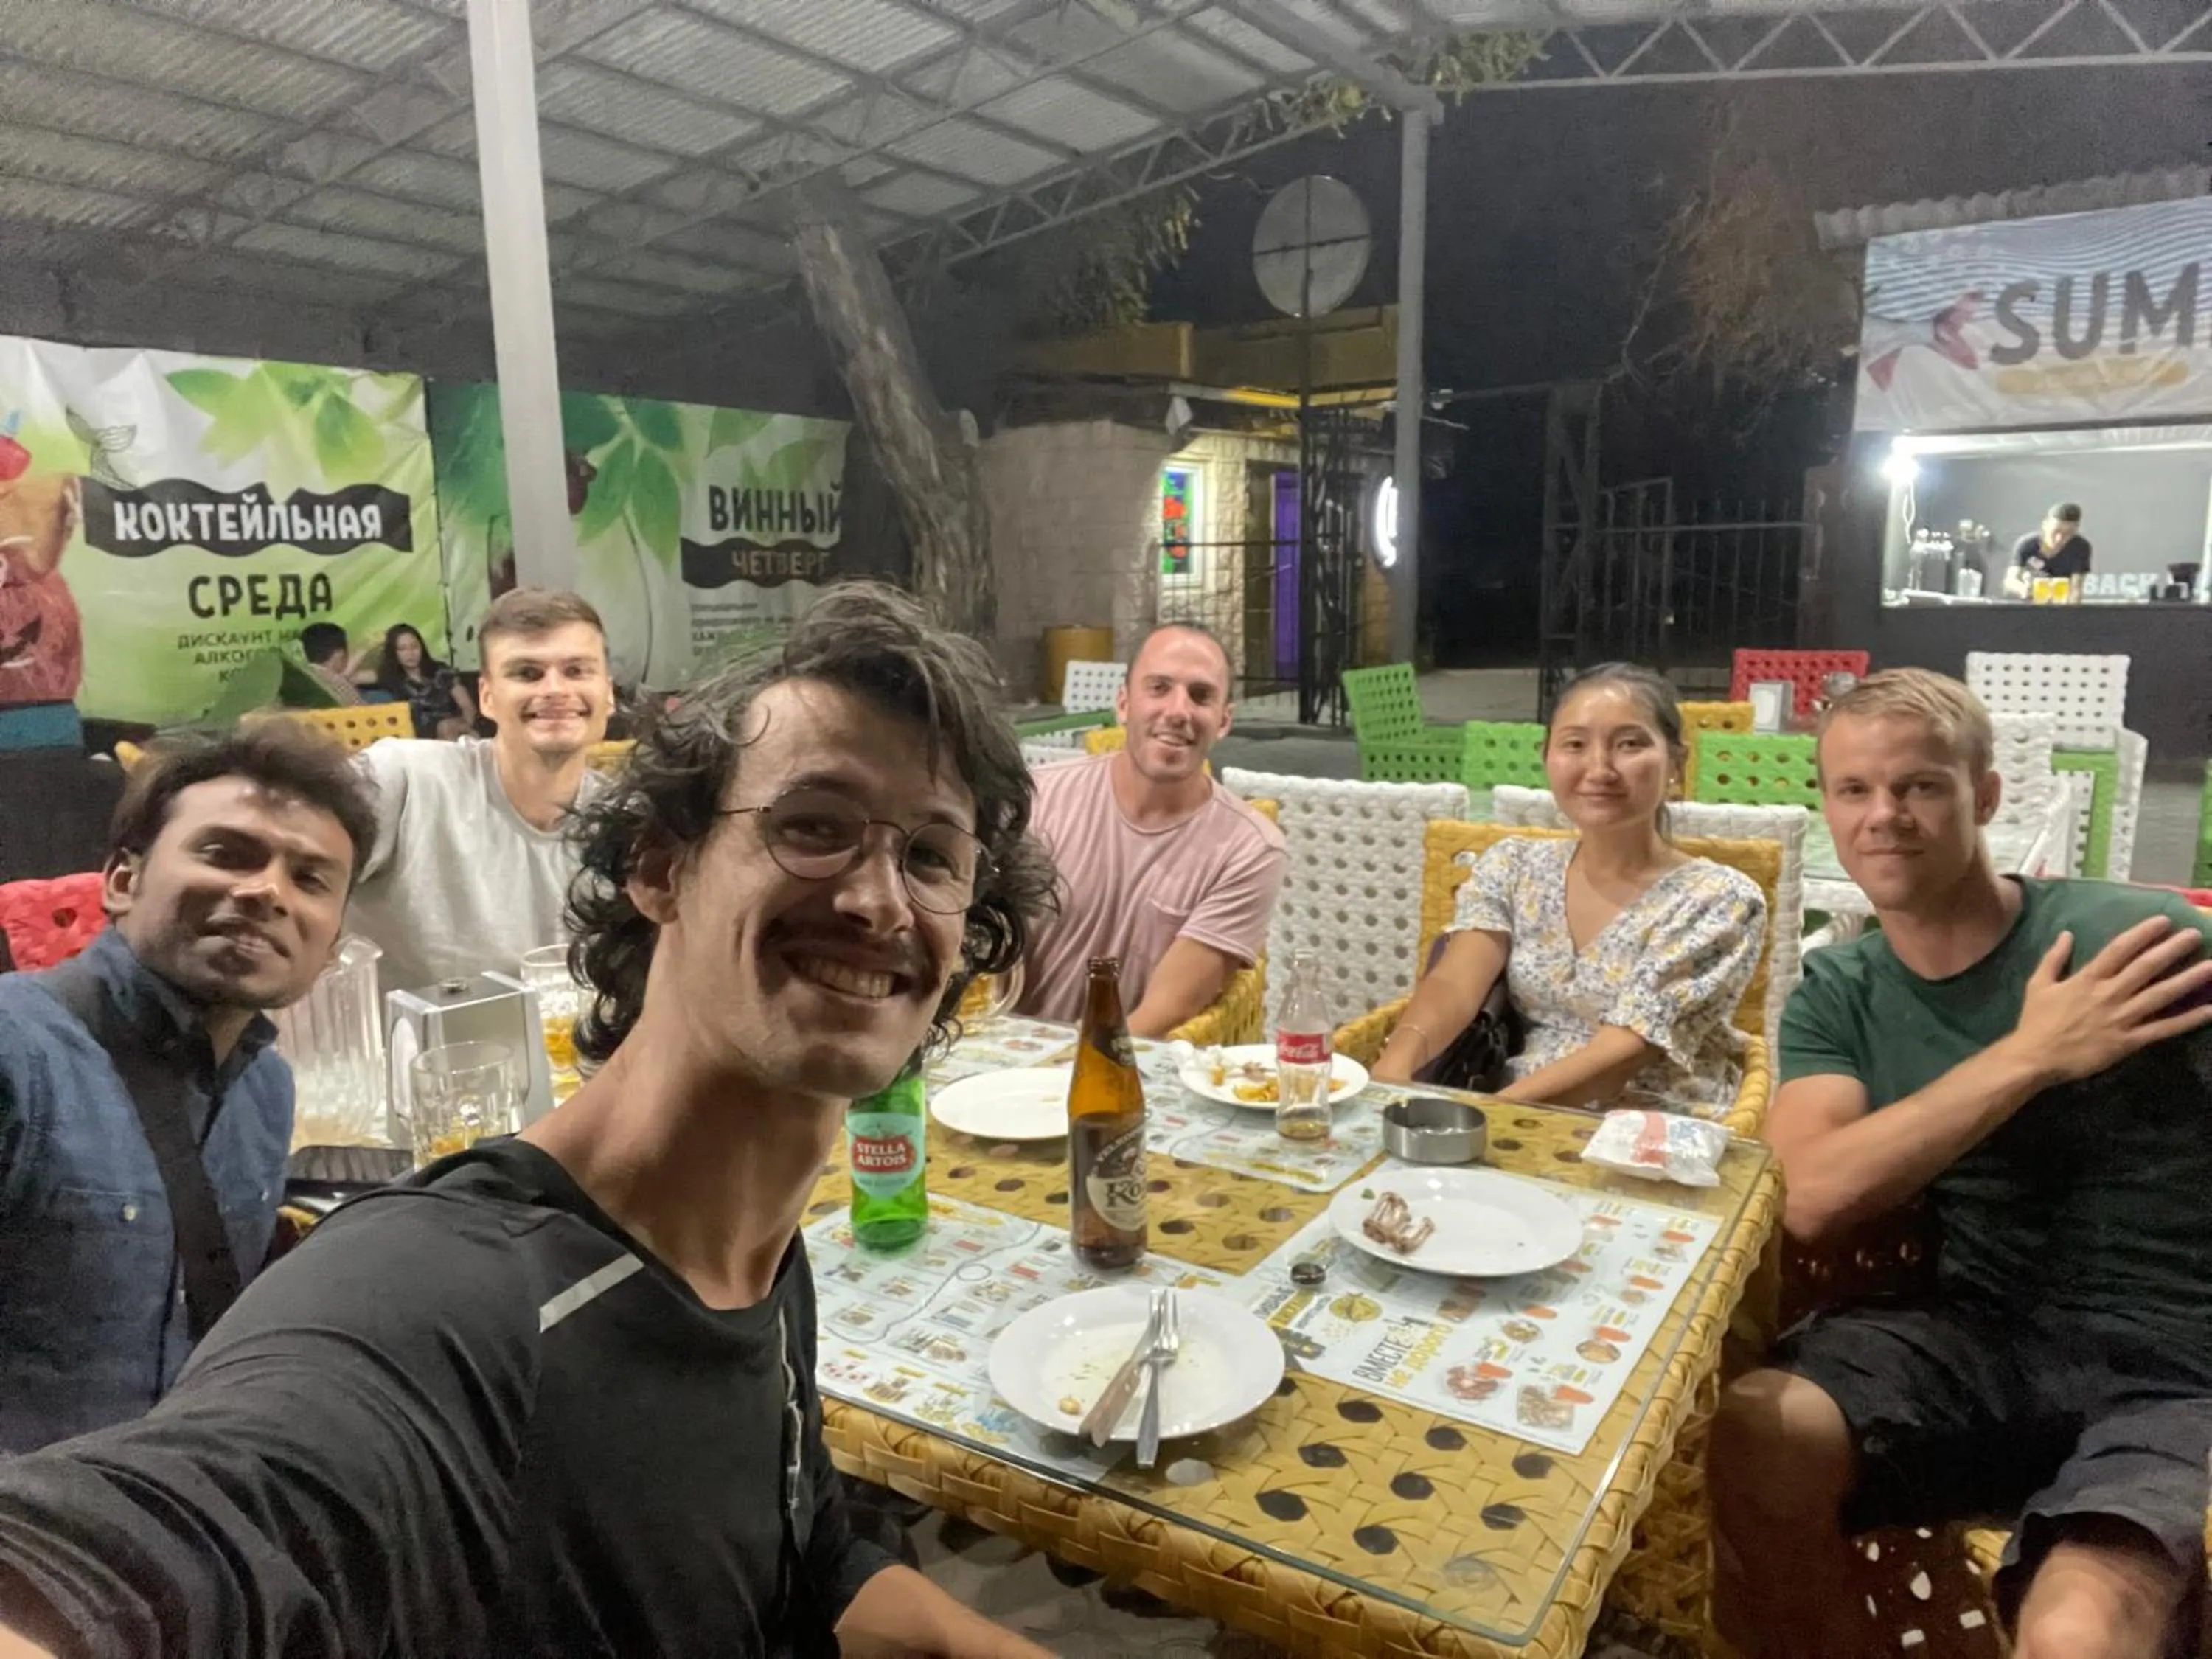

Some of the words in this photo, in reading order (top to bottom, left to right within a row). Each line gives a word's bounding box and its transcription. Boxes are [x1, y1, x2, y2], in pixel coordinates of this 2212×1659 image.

[1988, 261, 2212, 364] SUM
[113, 493, 383, 541] КОКТЕЙЛЬНАЯ
[708, 480, 841, 534] ВИННЫЙ
[731, 550, 829, 577] ЧЕТВЕРГ
[187, 572, 333, 620] СРЕДА
[177, 630, 272, 650] ДИСКАУНТ
[857, 1142, 906, 1155] STELLA
[858, 1153, 907, 1167] ARTOIS
